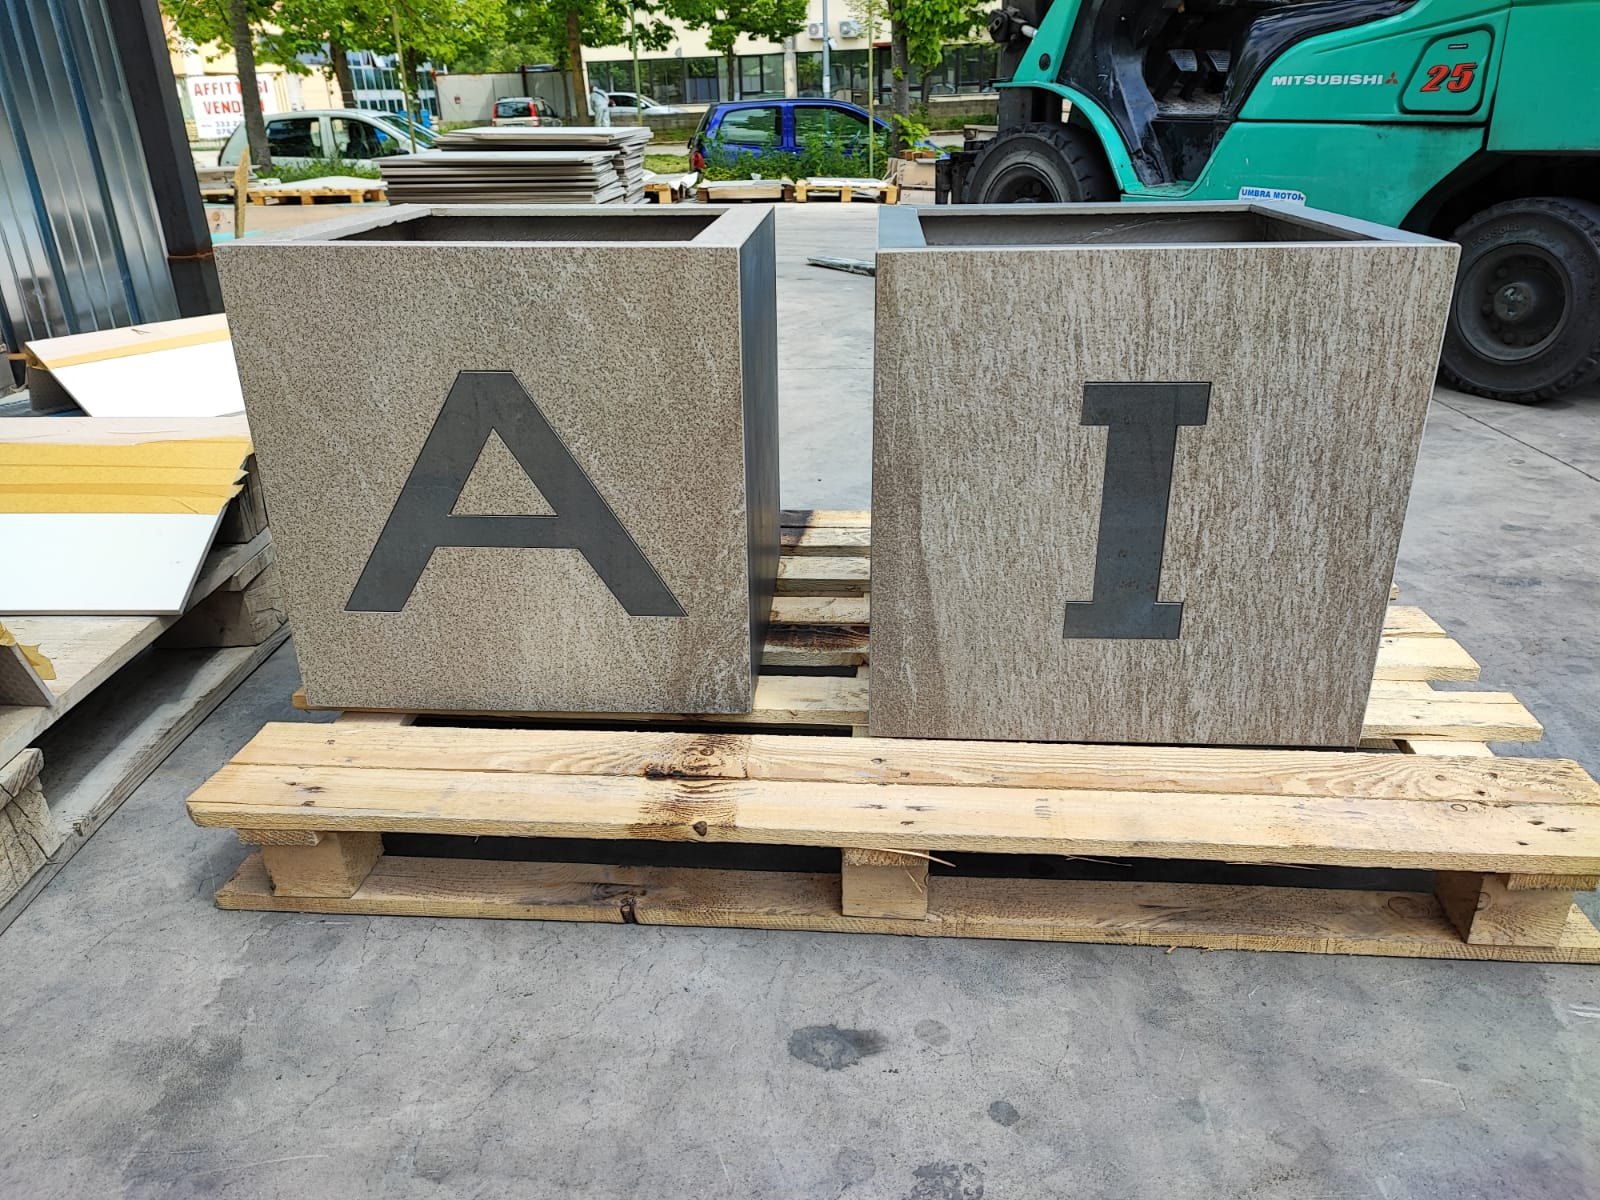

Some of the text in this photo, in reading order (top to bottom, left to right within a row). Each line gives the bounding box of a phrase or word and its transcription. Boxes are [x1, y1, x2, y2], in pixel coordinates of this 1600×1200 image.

[194, 80, 268, 97] AFFITTSI
[1271, 74, 1384, 86] MITSUBISHI
[1420, 63, 1478, 93] 25
[1241, 188, 1271, 199] UMBRA
[344, 370, 689, 616] A
[1063, 381, 1212, 639] I
